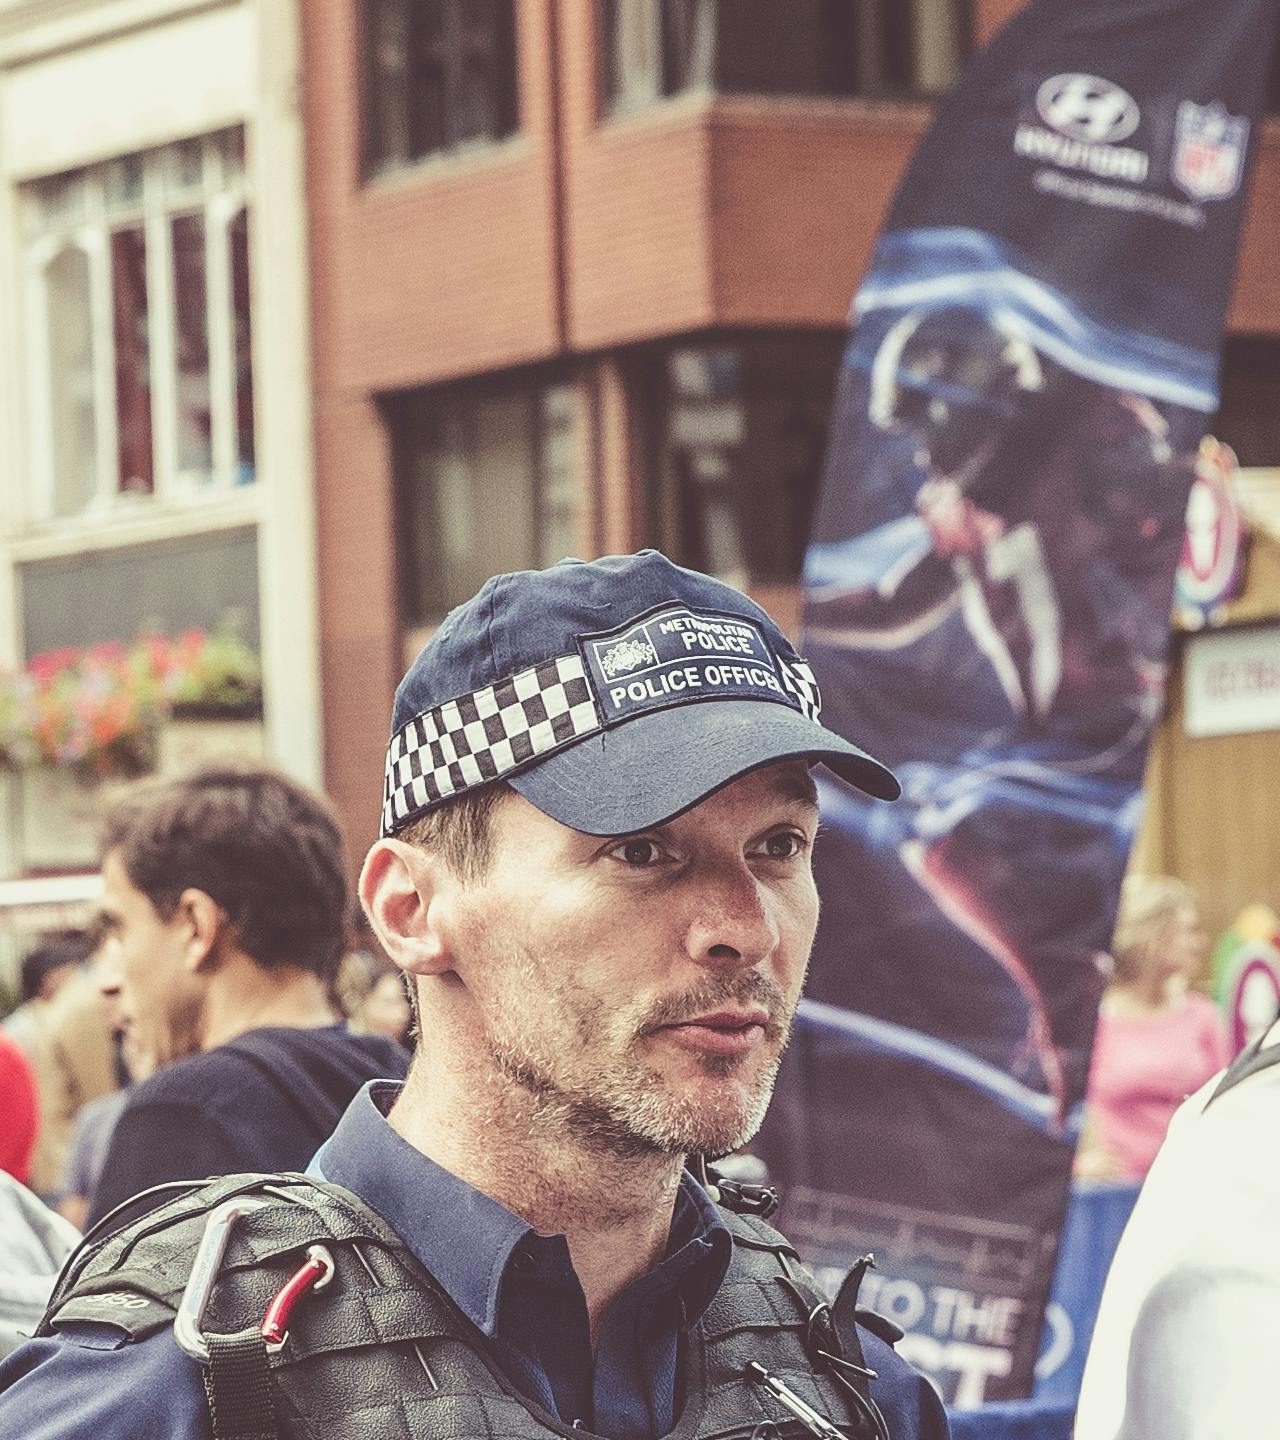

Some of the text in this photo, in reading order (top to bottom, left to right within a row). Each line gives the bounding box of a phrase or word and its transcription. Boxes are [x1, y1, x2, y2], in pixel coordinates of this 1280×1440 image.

[658, 617, 755, 640] METROPOLITAN
[681, 631, 755, 655] POLICE
[609, 665, 786, 709] POLICE OFFICER
[930, 1285, 1021, 1345] THE
